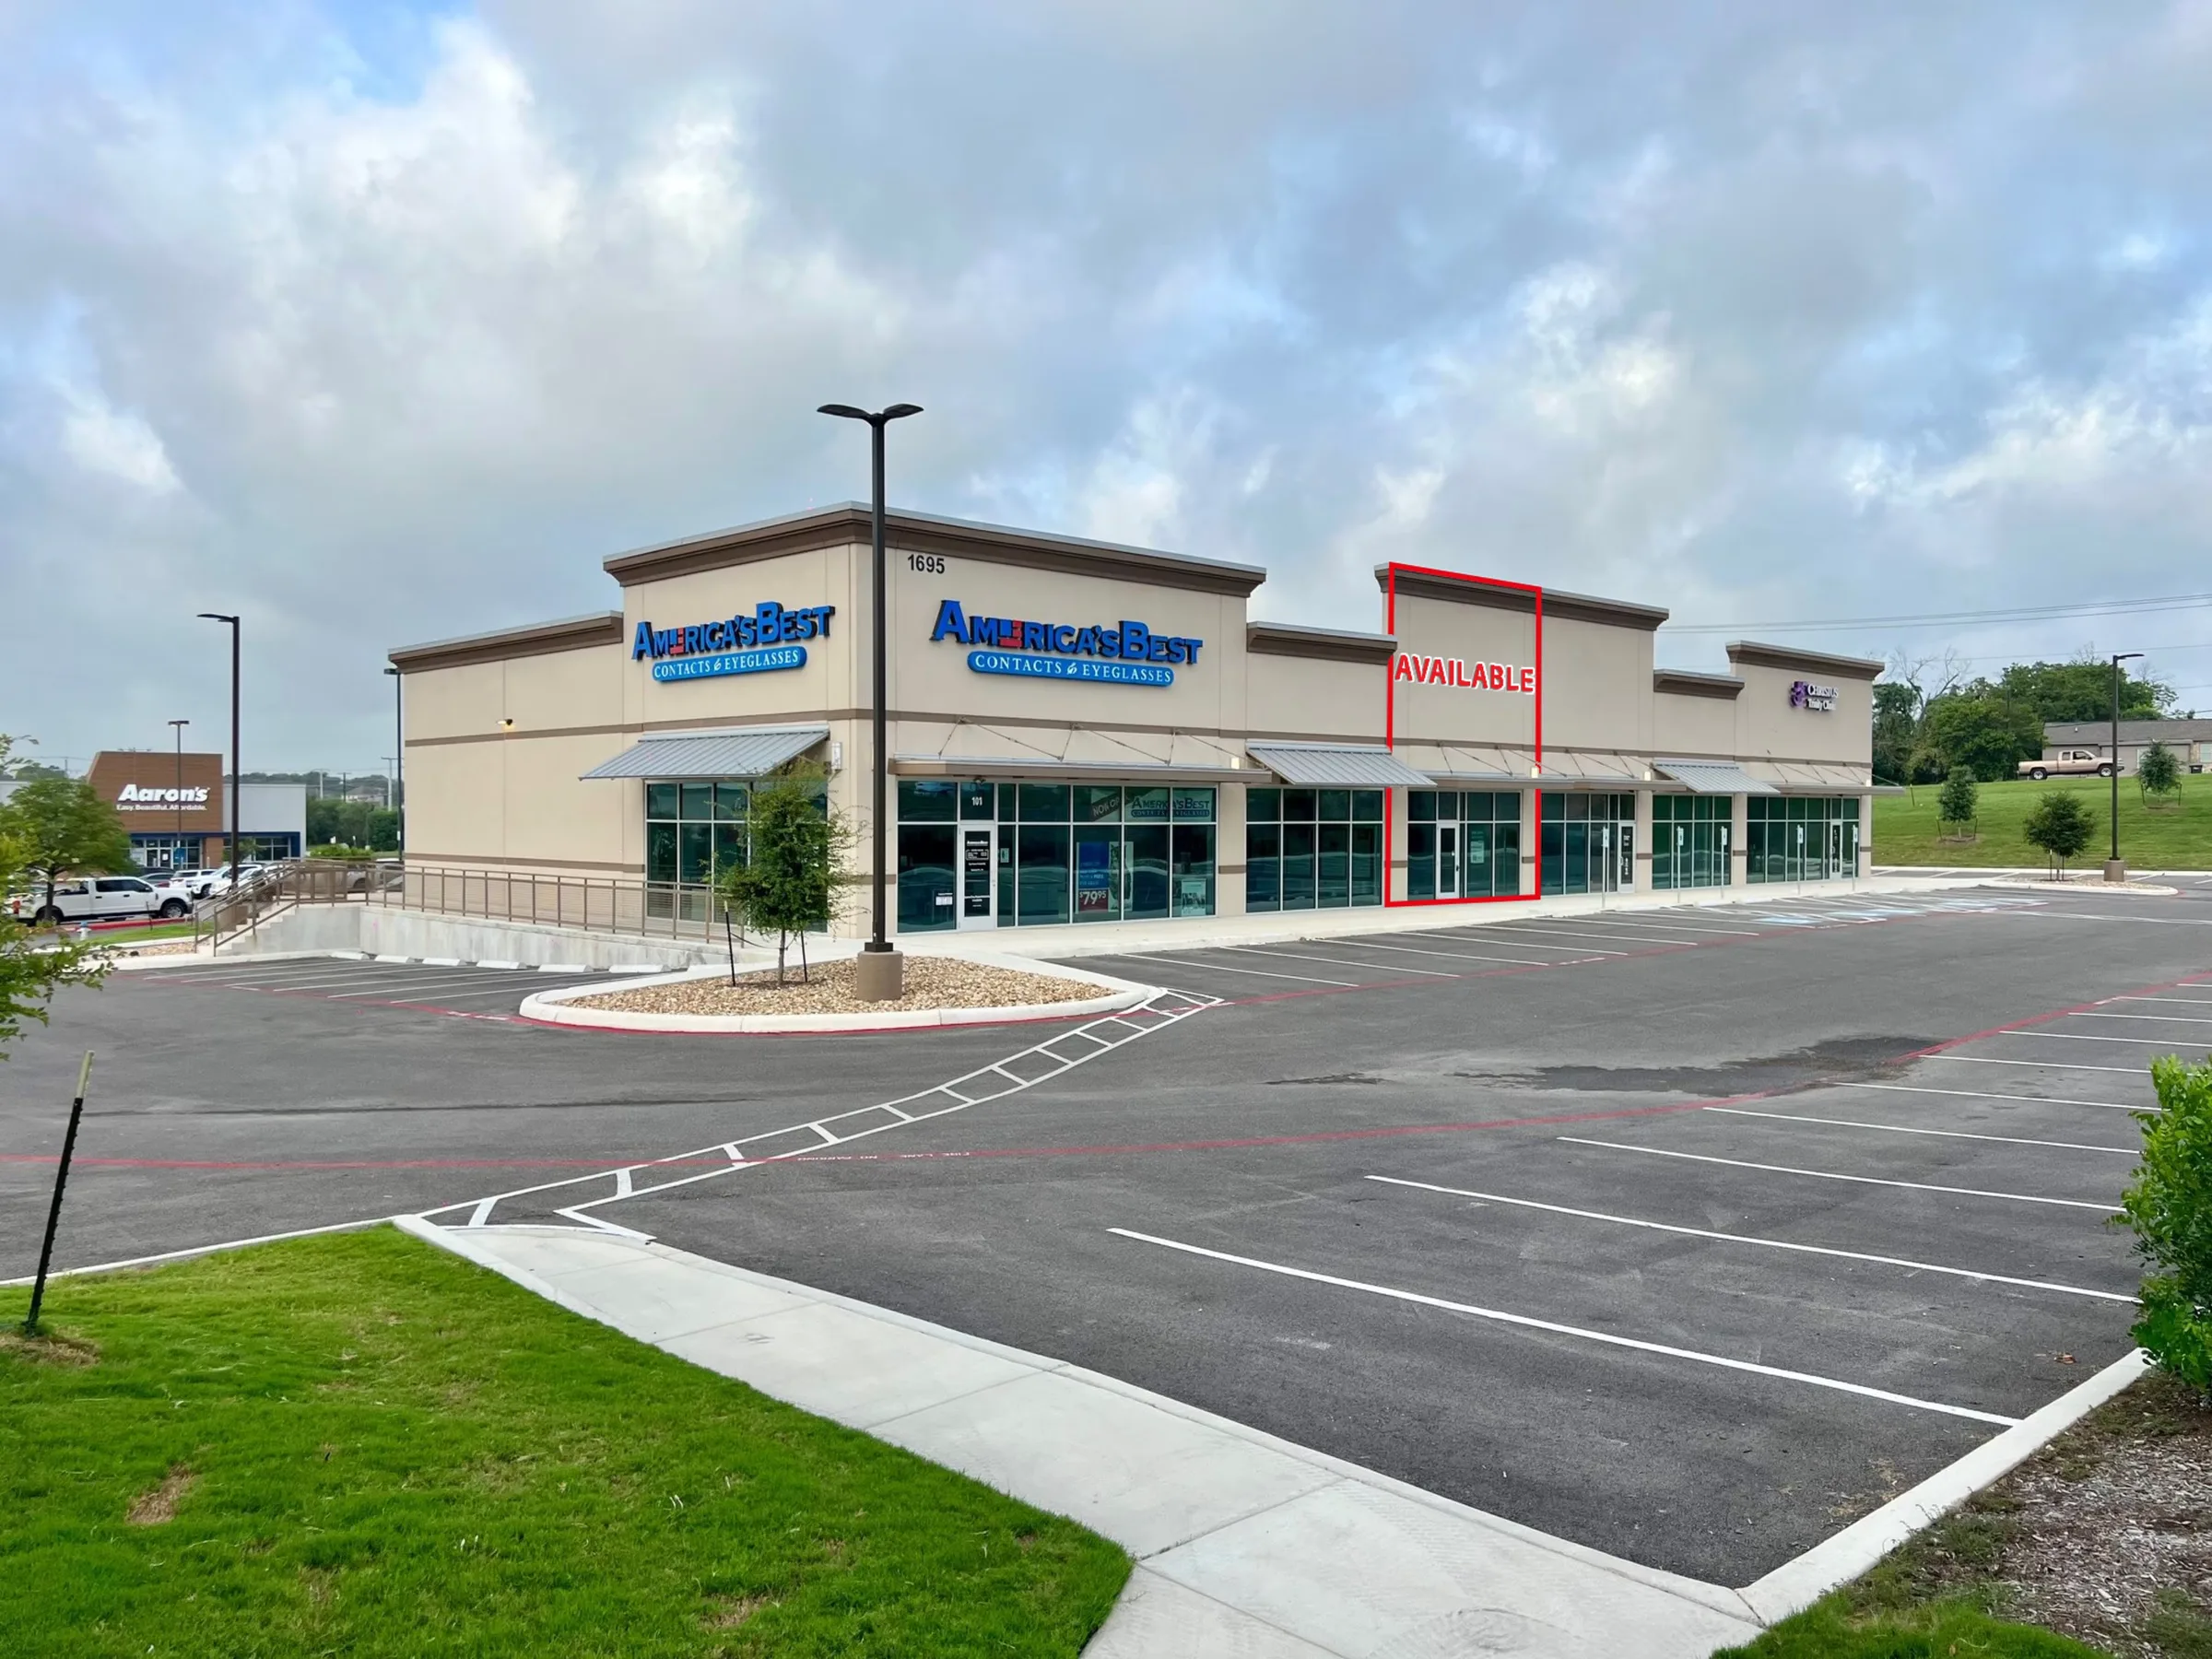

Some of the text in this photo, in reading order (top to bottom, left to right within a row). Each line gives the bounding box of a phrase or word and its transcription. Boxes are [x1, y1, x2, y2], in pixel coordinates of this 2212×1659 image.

[908, 554, 946, 574] 1695
[631, 601, 835, 661] AMERICA'S BEST
[929, 599, 1203, 665] AMERICA'S BEST
[653, 660, 711, 678] CONTACTS
[724, 649, 799, 671] EYEGLASSES
[975, 654, 1062, 674] CONTACTS
[1082, 665, 1171, 683] EYEGLASSES
[117, 783, 208, 802] Aaron's
[971, 796, 982, 806] 101
